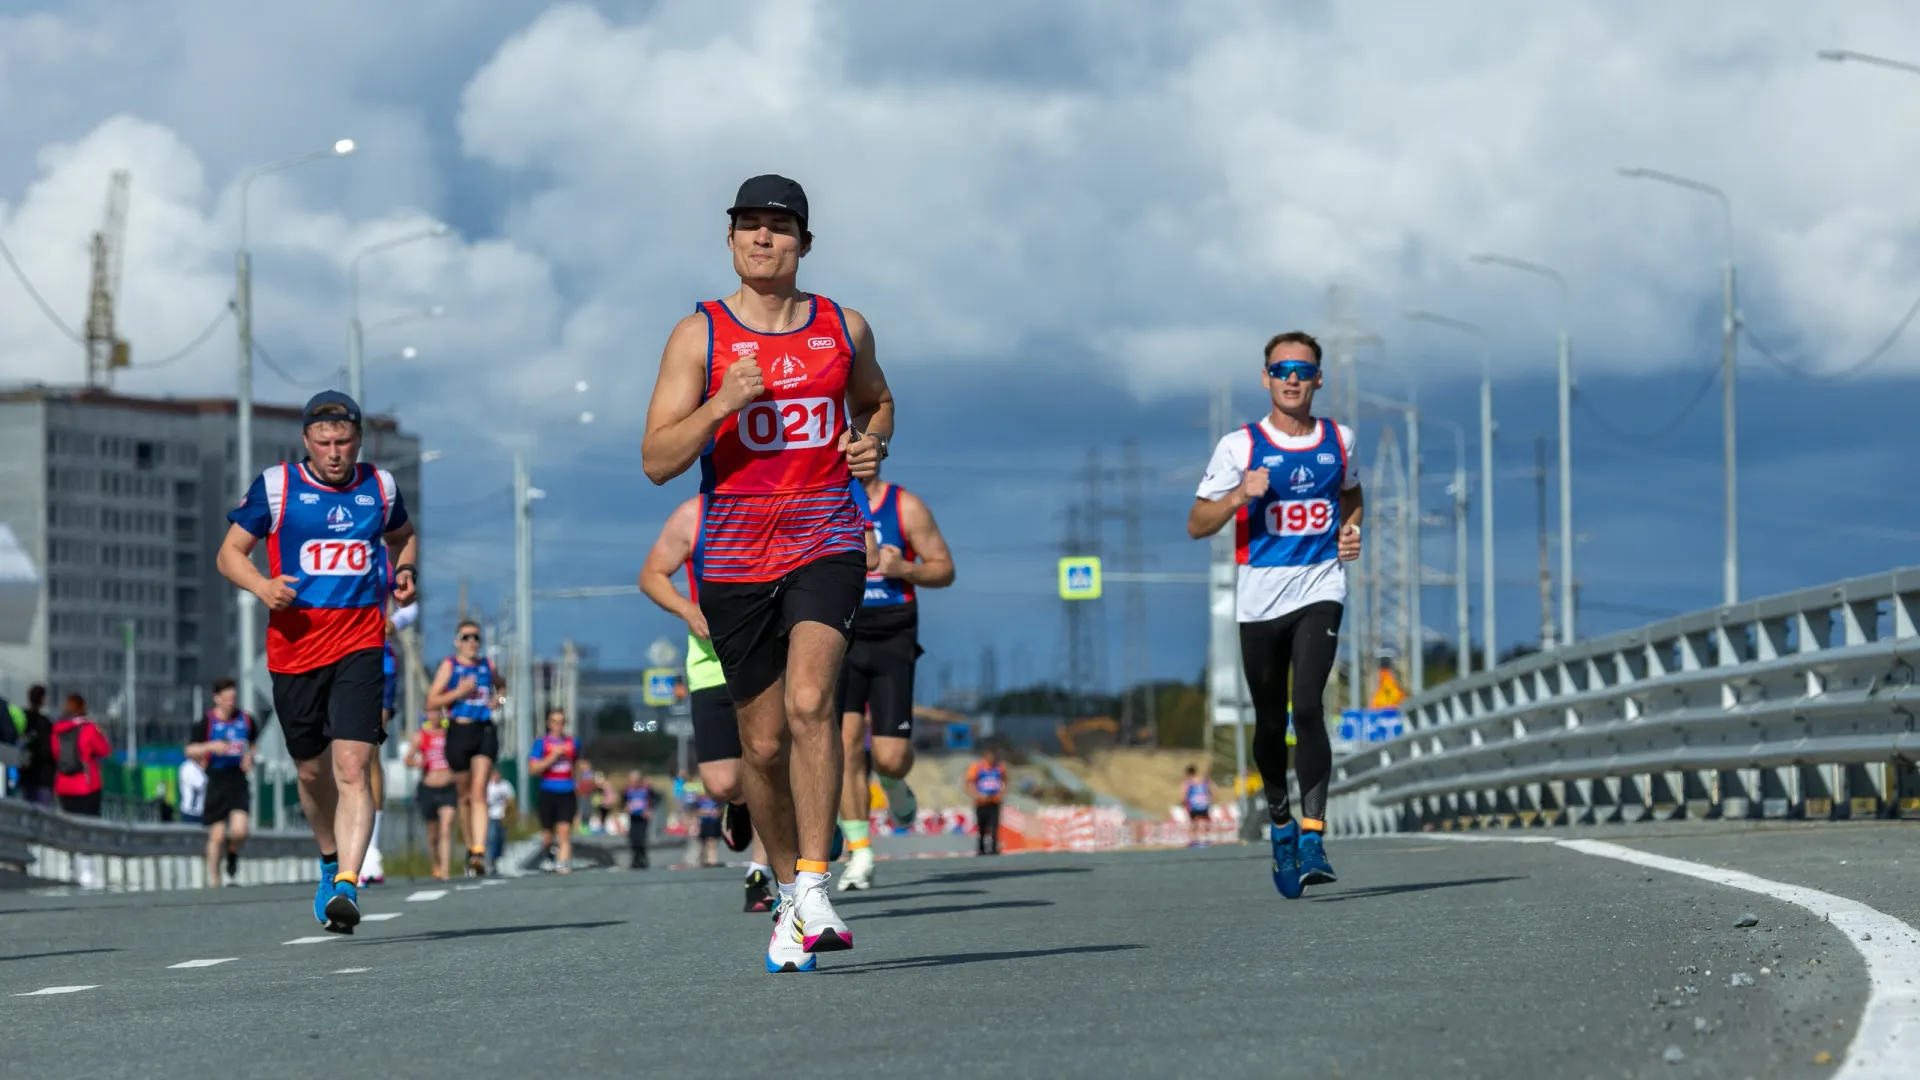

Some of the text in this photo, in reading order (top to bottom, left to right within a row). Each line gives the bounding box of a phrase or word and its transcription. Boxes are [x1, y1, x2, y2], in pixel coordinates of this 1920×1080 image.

[773, 374, 807, 386] ПОЛЯРНЫЙ
[783, 382, 798, 390] КРУГ
[747, 403, 828, 444] 021
[1270, 502, 1328, 531] 199
[307, 543, 366, 570] 170
